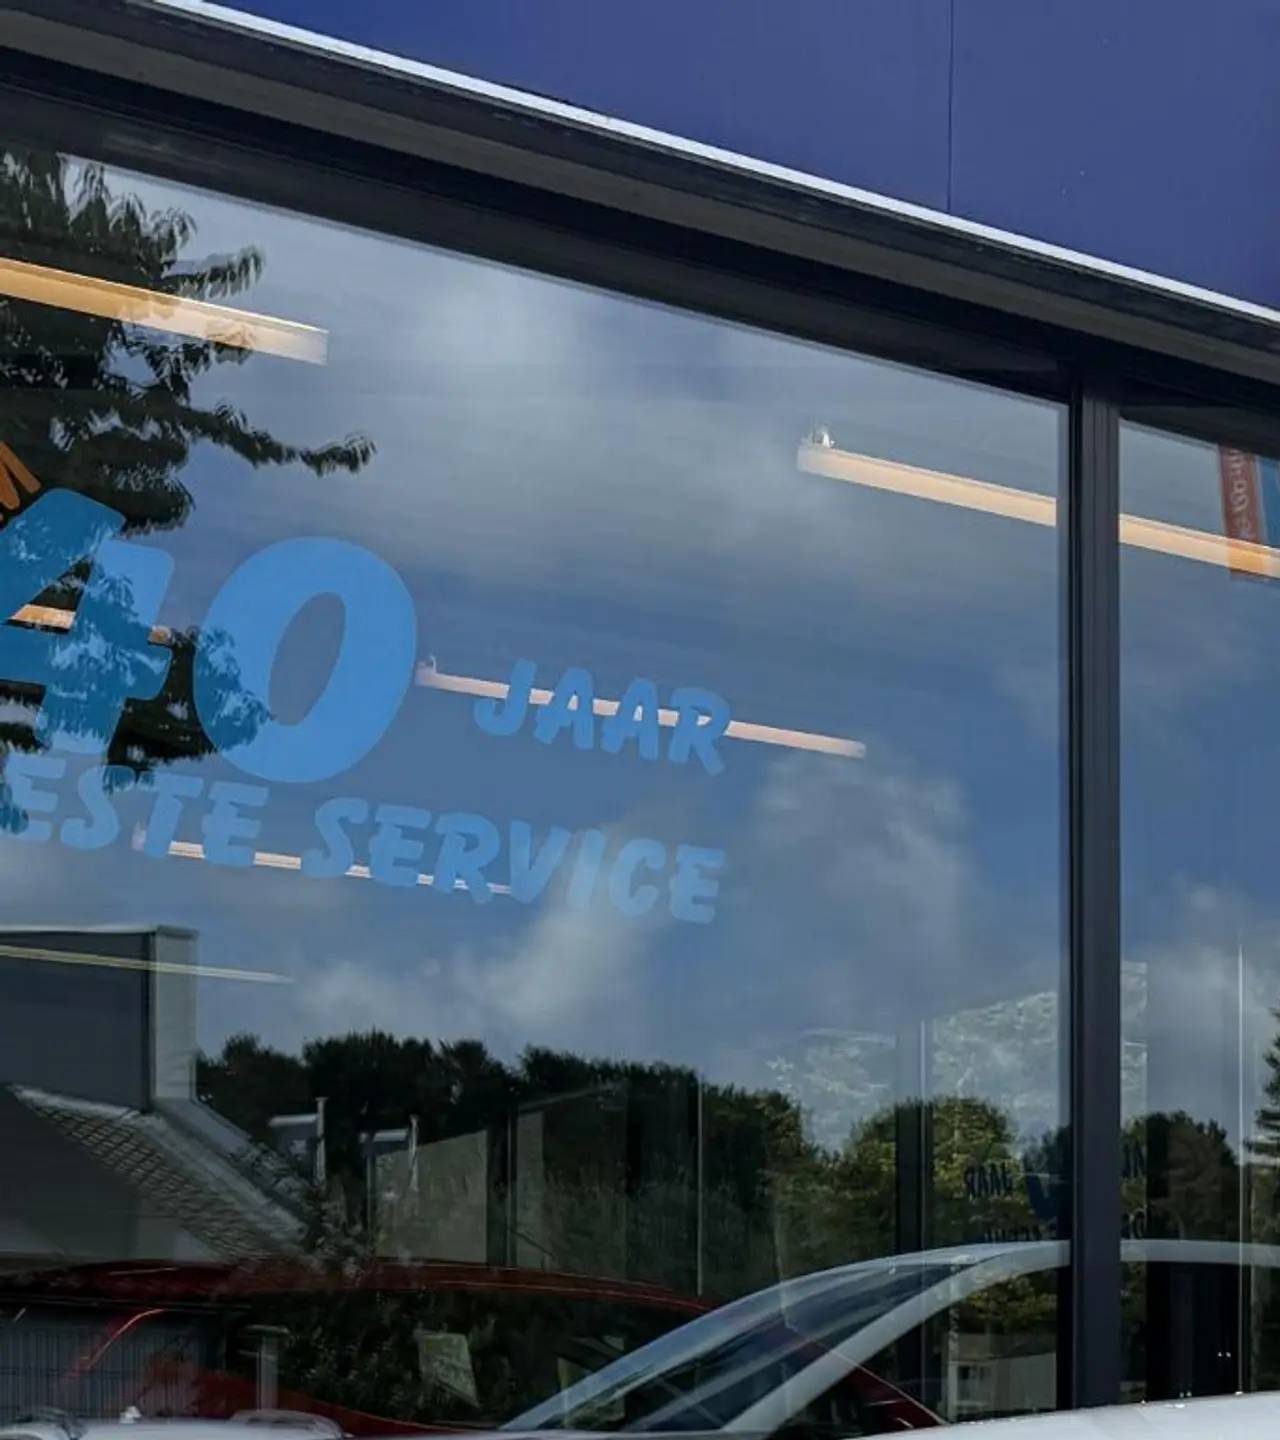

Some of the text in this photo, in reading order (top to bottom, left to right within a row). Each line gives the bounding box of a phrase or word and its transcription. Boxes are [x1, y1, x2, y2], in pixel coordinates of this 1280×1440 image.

[0, 487, 732, 784] 40 JAAR
[0, 750, 727, 925] ESTE SERVICE
